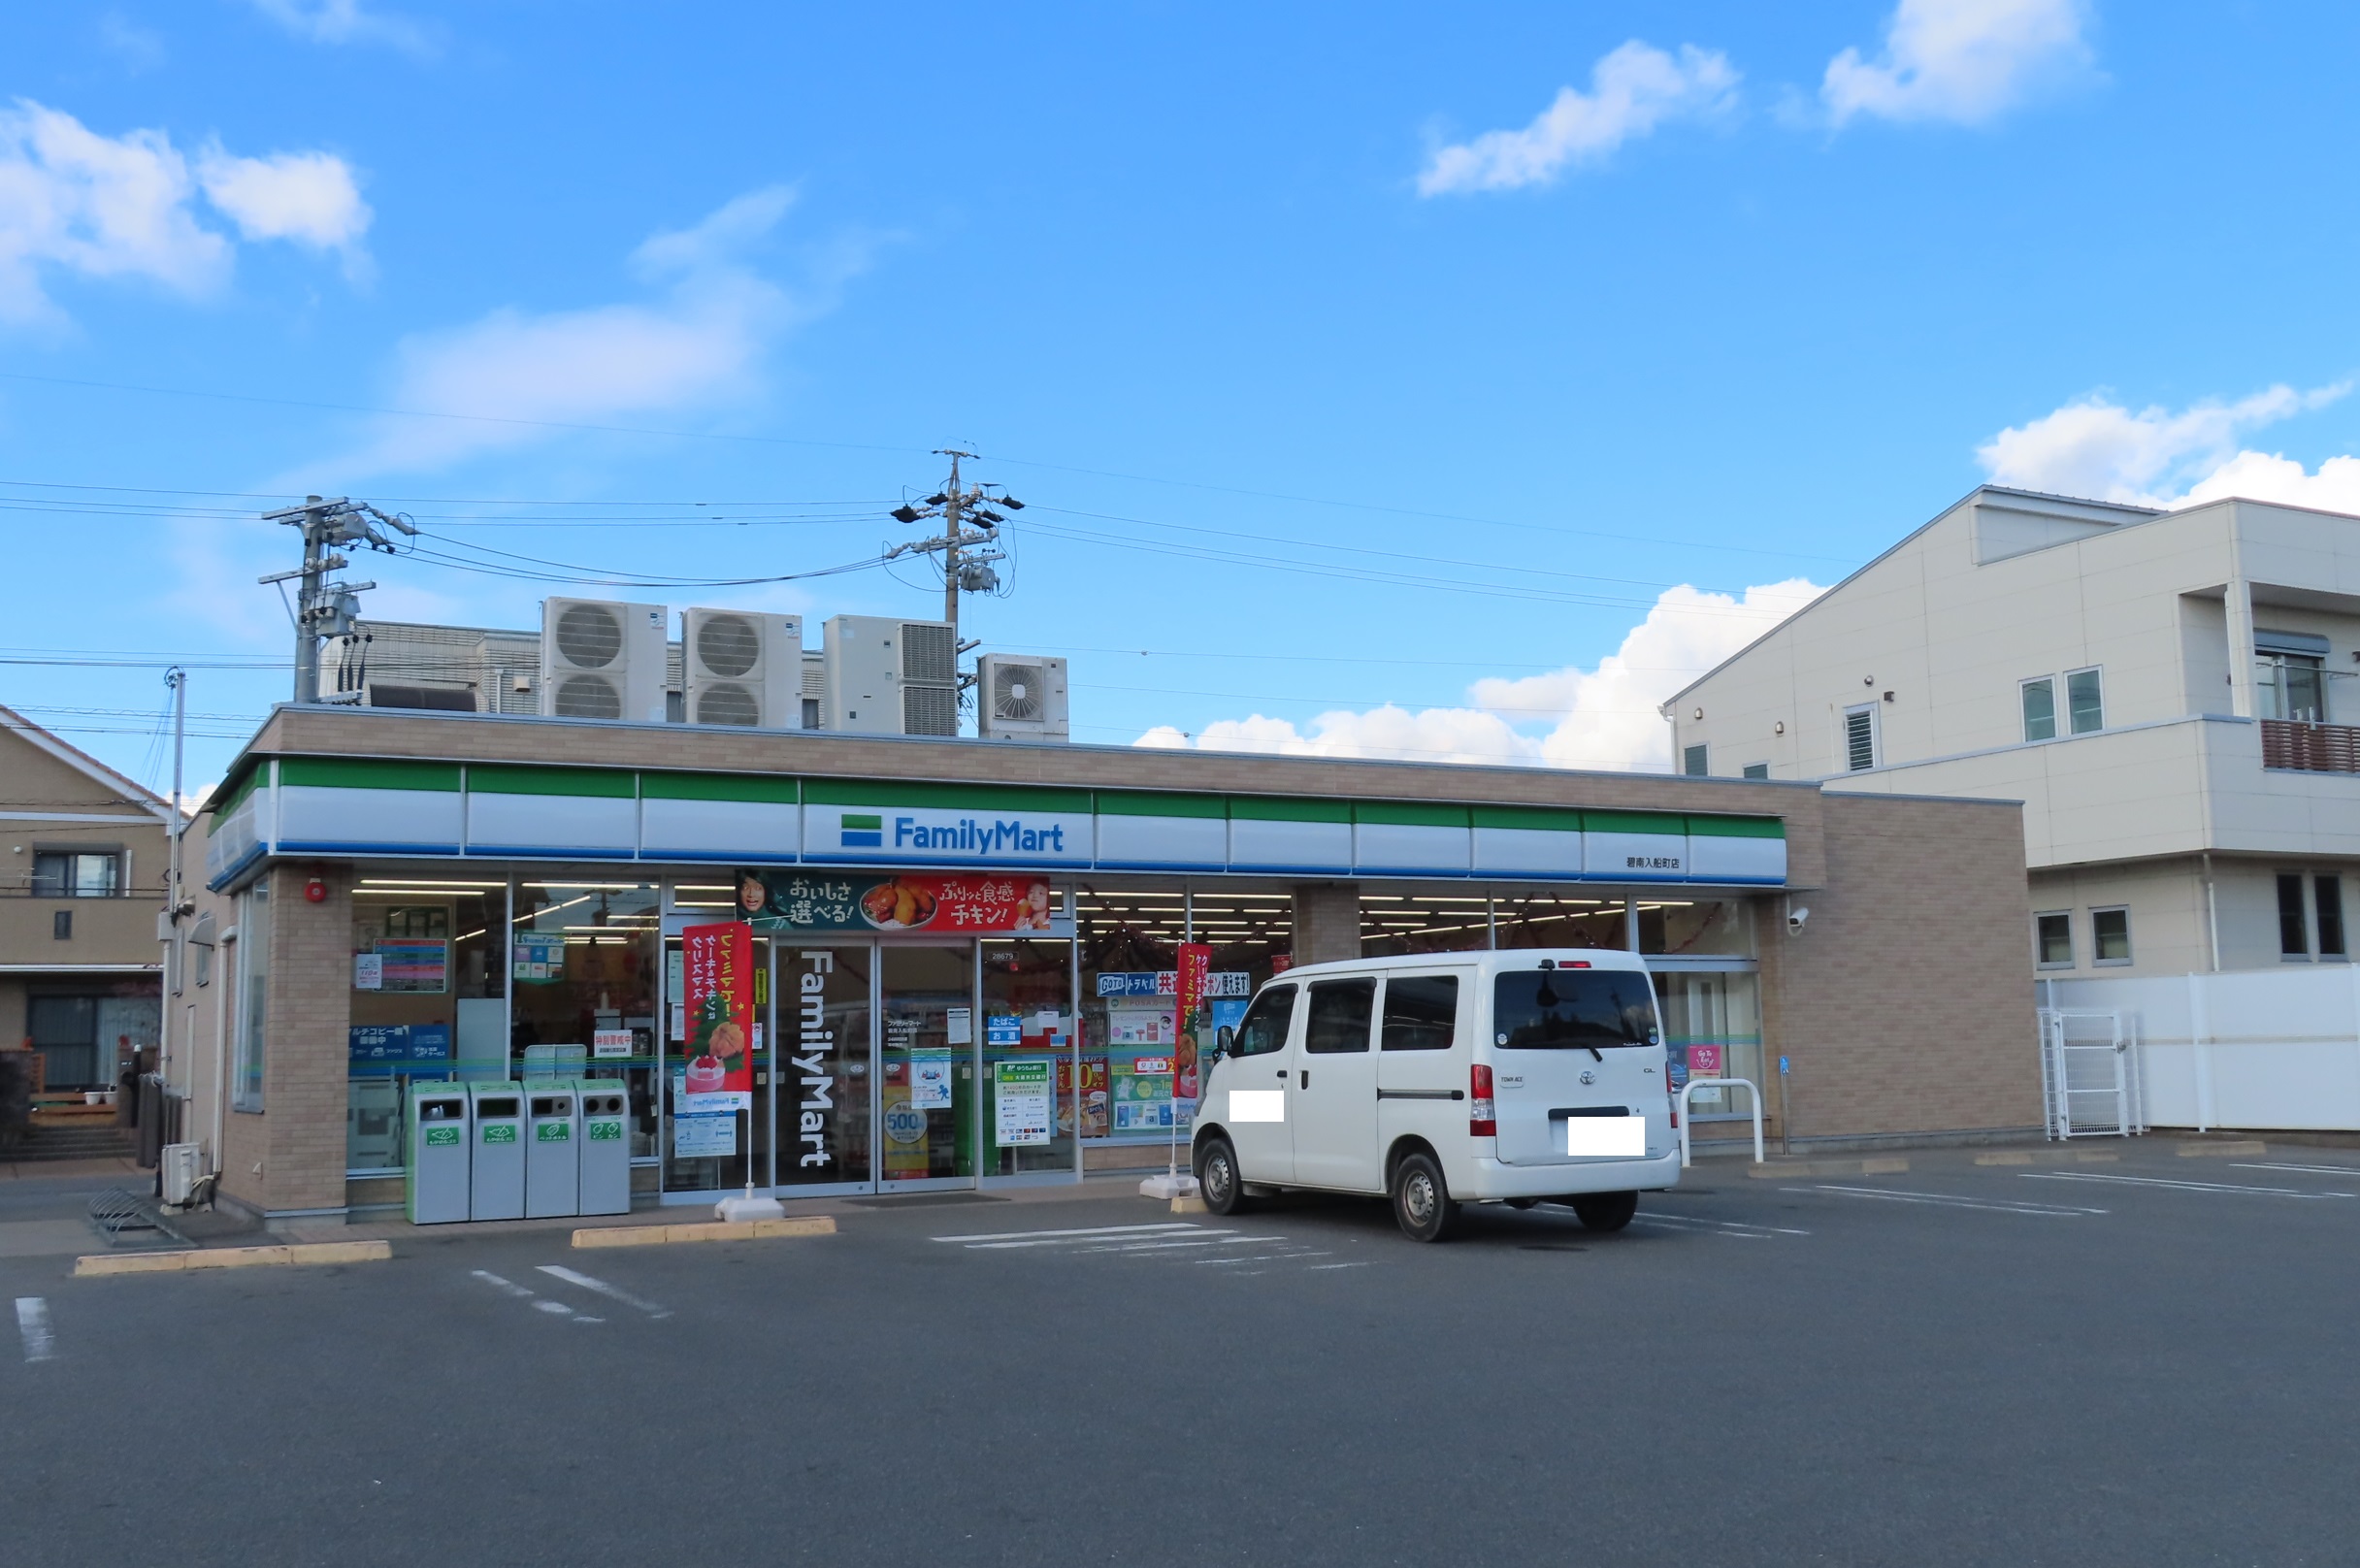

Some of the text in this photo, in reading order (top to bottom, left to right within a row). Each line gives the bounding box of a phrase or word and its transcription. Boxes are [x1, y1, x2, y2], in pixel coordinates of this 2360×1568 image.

[895, 817, 1064, 854] FamilyMart
[1626, 857, 1680, 868] 碧南入船町店
[789, 876, 851, 900] おいしさ
[790, 899, 855, 924] 選べる!
[950, 903, 1008, 926] チキン!
[1127, 978, 1156, 991] トラベル
[1182, 954, 1196, 1029] ファミマで!
[993, 1018, 1016, 1027] たばこ
[993, 1031, 1016, 1040] お酒
[791, 950, 833, 1167] FamilyMart
[887, 1113, 919, 1130] 500
